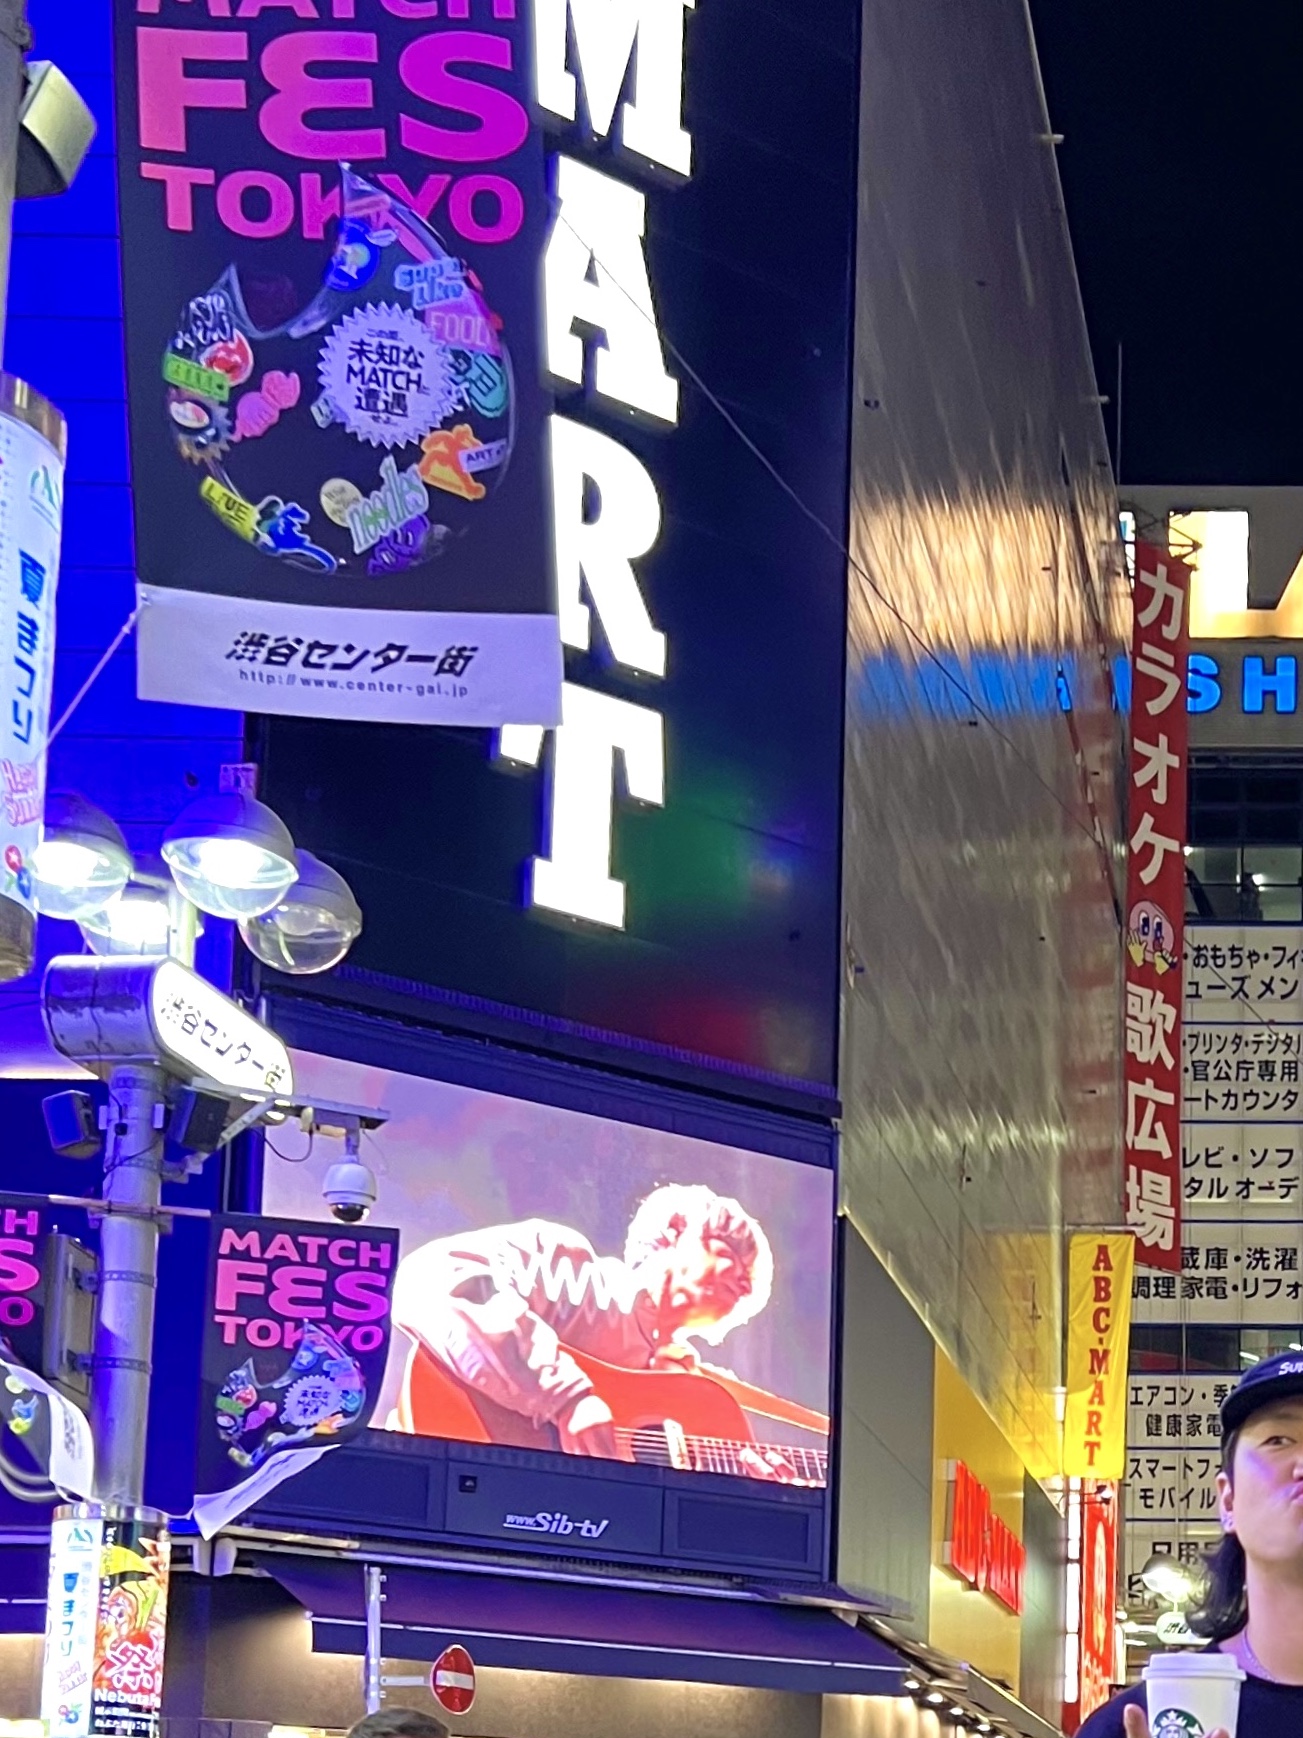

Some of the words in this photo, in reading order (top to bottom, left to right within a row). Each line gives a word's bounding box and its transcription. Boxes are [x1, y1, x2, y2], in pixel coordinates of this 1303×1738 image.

[136, 27, 530, 161] FES
[225, 630, 480, 679] 渋谷センター街
[1130, 560, 1187, 887] カラオケ
[1124, 980, 1177, 1252] 歌広場
[213, 1258, 391, 1323] FES
[218, 1227, 393, 1269] MATCH
